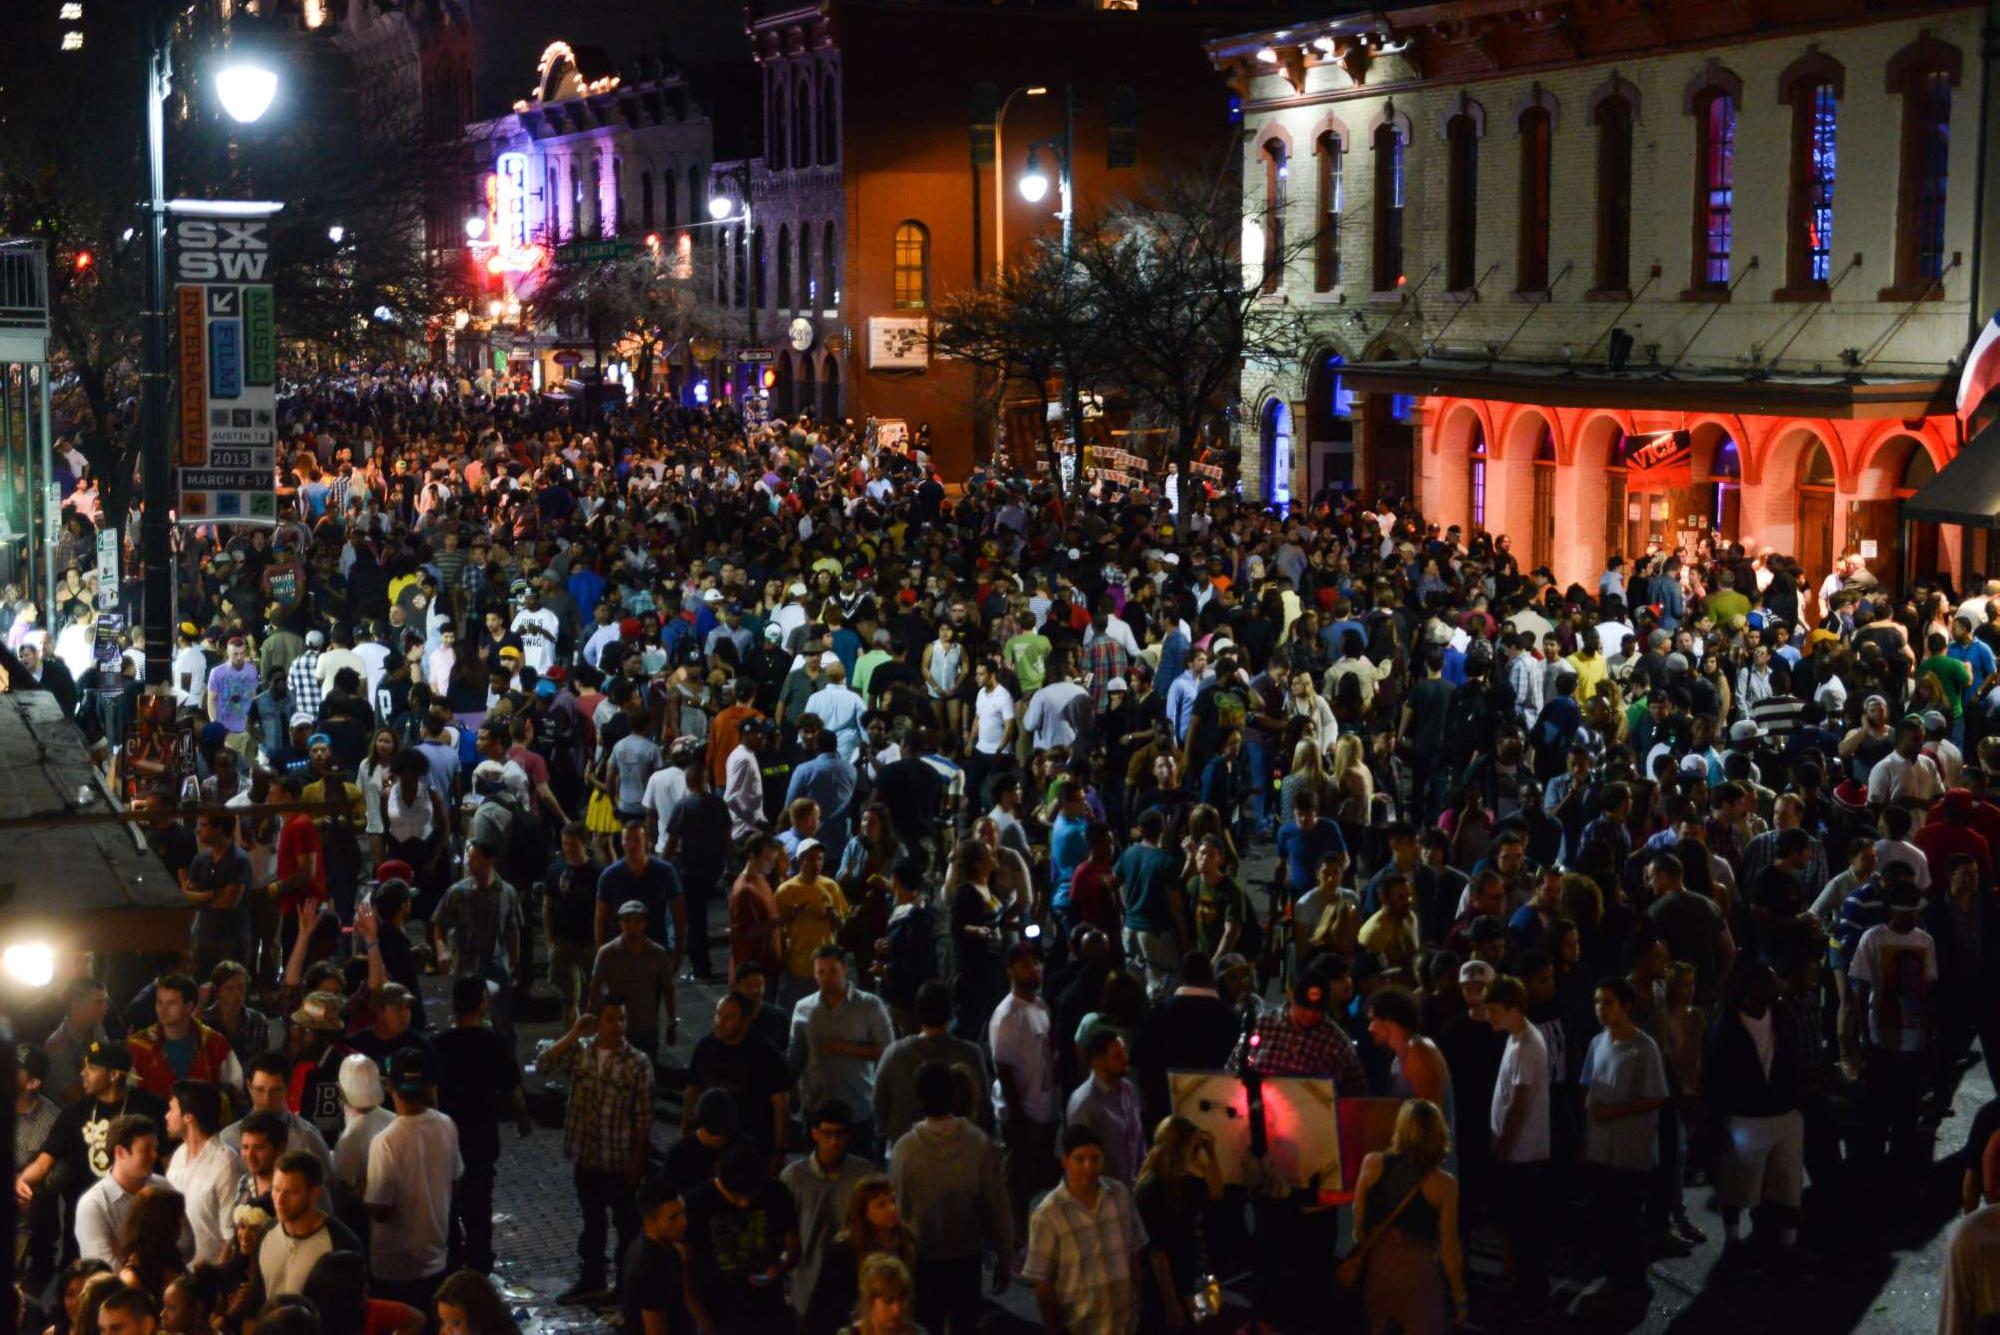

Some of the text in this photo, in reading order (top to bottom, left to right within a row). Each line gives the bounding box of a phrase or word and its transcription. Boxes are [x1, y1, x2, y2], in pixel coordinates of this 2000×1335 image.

[178, 221, 268, 249] SX
[178, 251, 268, 280] SW
[253, 292, 270, 379] MUSIC
[218, 326, 236, 389] FILM
[184, 290, 202, 460] INTERACTIVE
[212, 431, 251, 440] AUSTIN
[213, 452, 249, 465] 2013
[187, 475, 234, 485] MARCH
